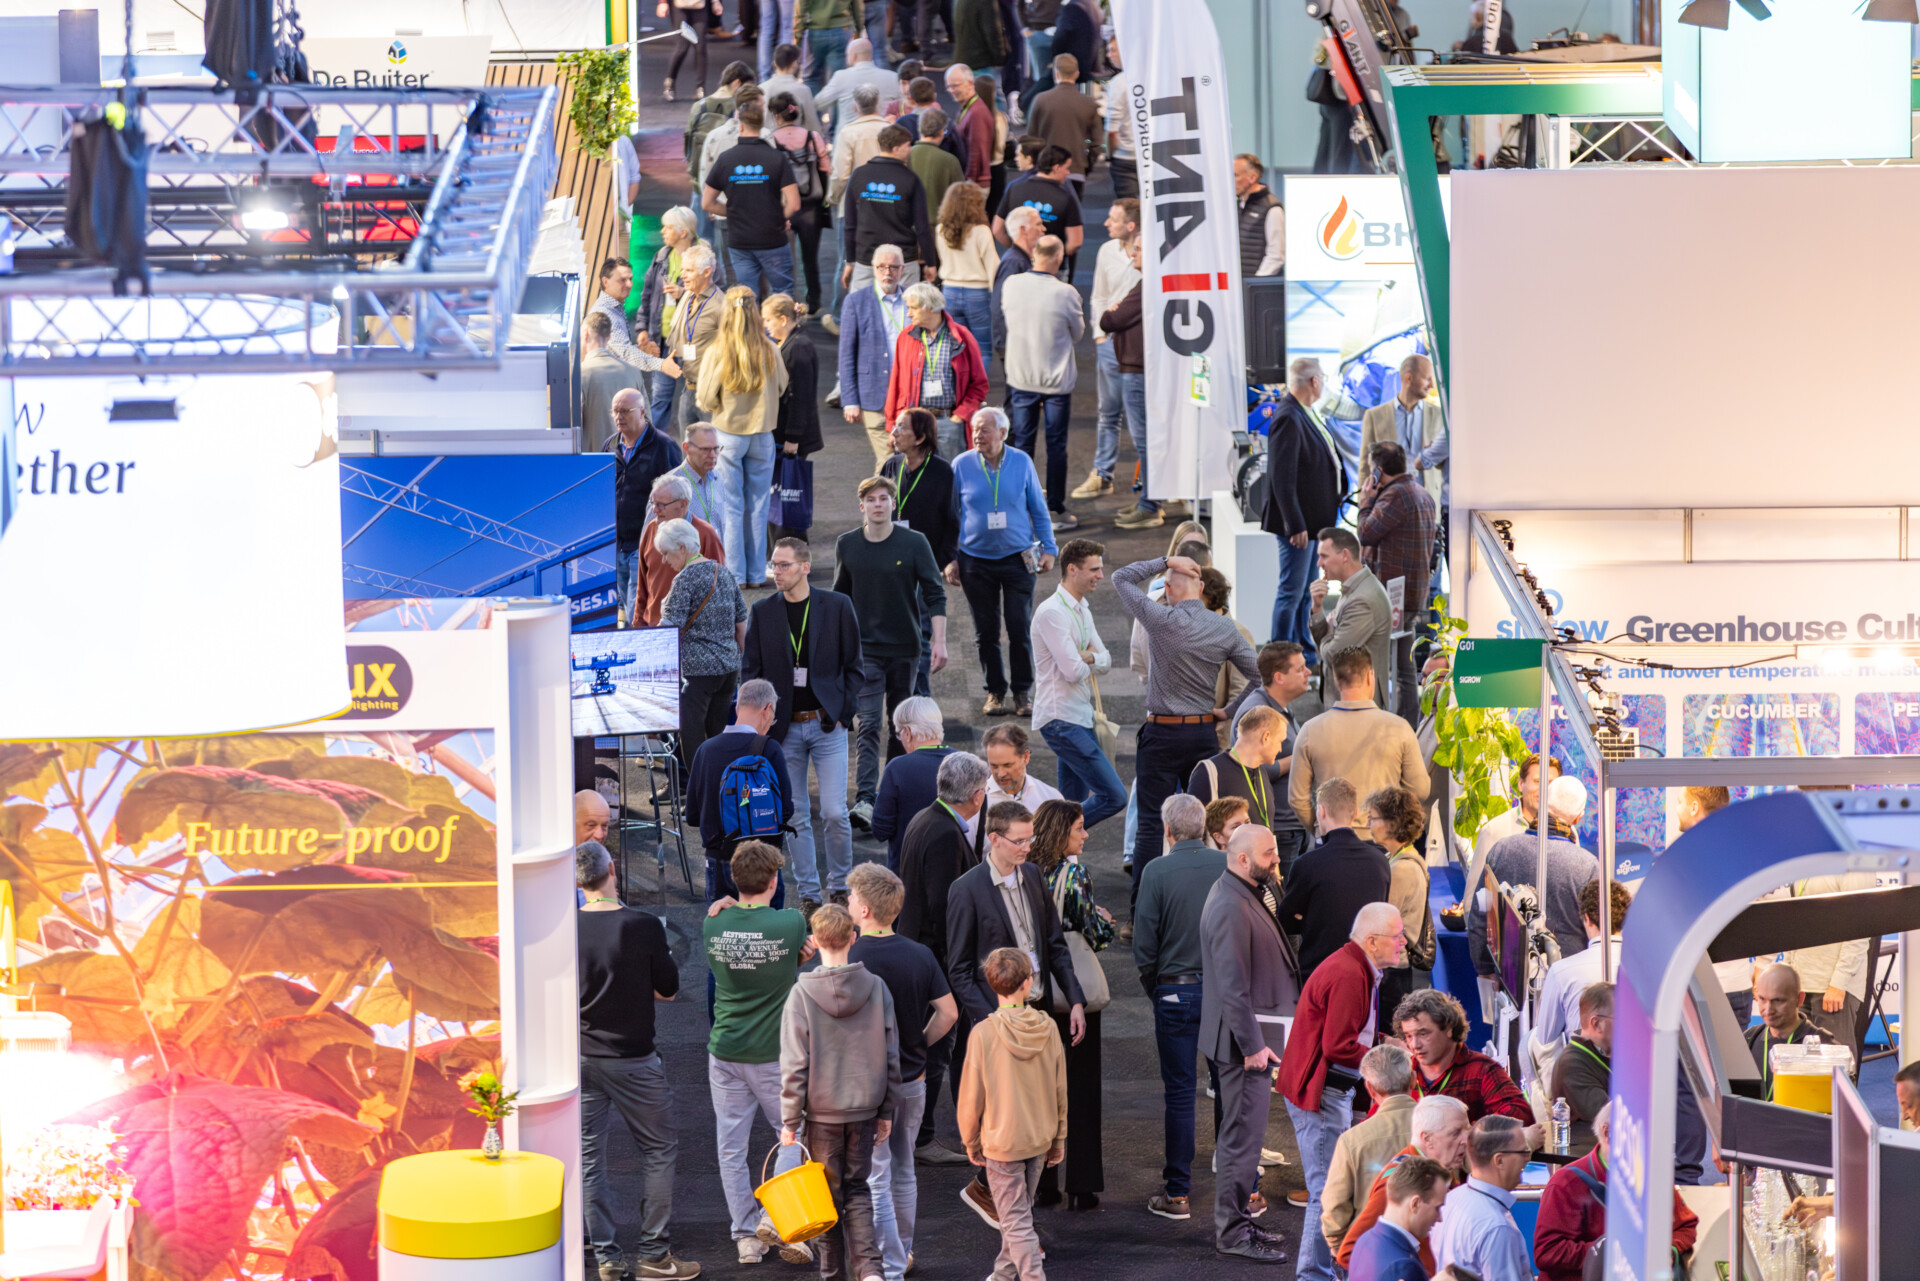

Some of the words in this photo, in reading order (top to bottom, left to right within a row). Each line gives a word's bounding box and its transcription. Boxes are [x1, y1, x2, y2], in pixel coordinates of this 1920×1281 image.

[313, 70, 347, 88] De
[354, 69, 429, 88] Ruiter
[1626, 614, 1847, 643] Greenhouse
[1459, 640, 1475, 651] G01
[1459, 675, 1481, 684] SIGROW
[1706, 702, 1823, 719] CUCUMBER
[182, 815, 460, 864] Future-proof
